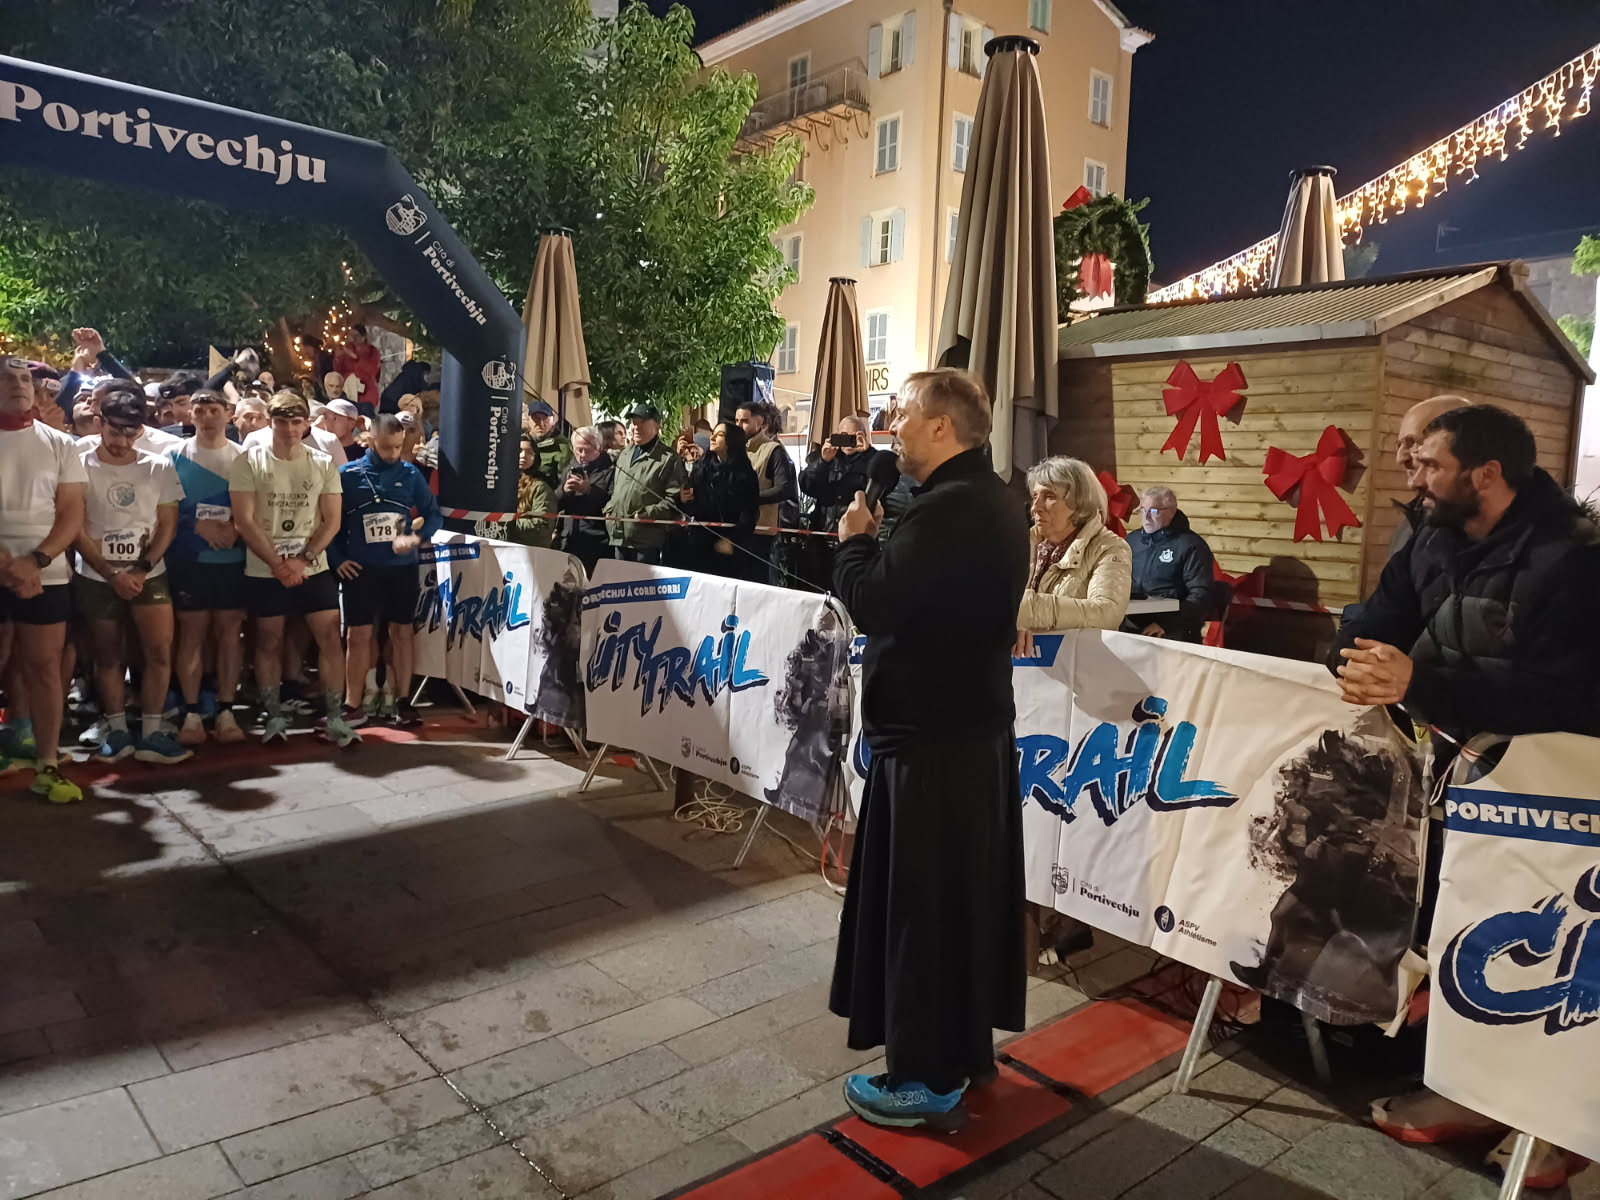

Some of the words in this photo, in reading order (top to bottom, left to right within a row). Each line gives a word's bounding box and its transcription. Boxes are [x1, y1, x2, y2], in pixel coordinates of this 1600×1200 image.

[0, 79, 327, 185] Portivechju
[422, 245, 487, 326] Portivechju
[865, 367, 889, 391] IRS
[484, 405, 502, 489] Portivechju
[370, 525, 392, 537] 178
[108, 542, 135, 555] 100
[1079, 886, 1140, 918] Portivechju
[1178, 919, 1200, 931] ASPV
[888, 1090, 928, 1106] HOKA
